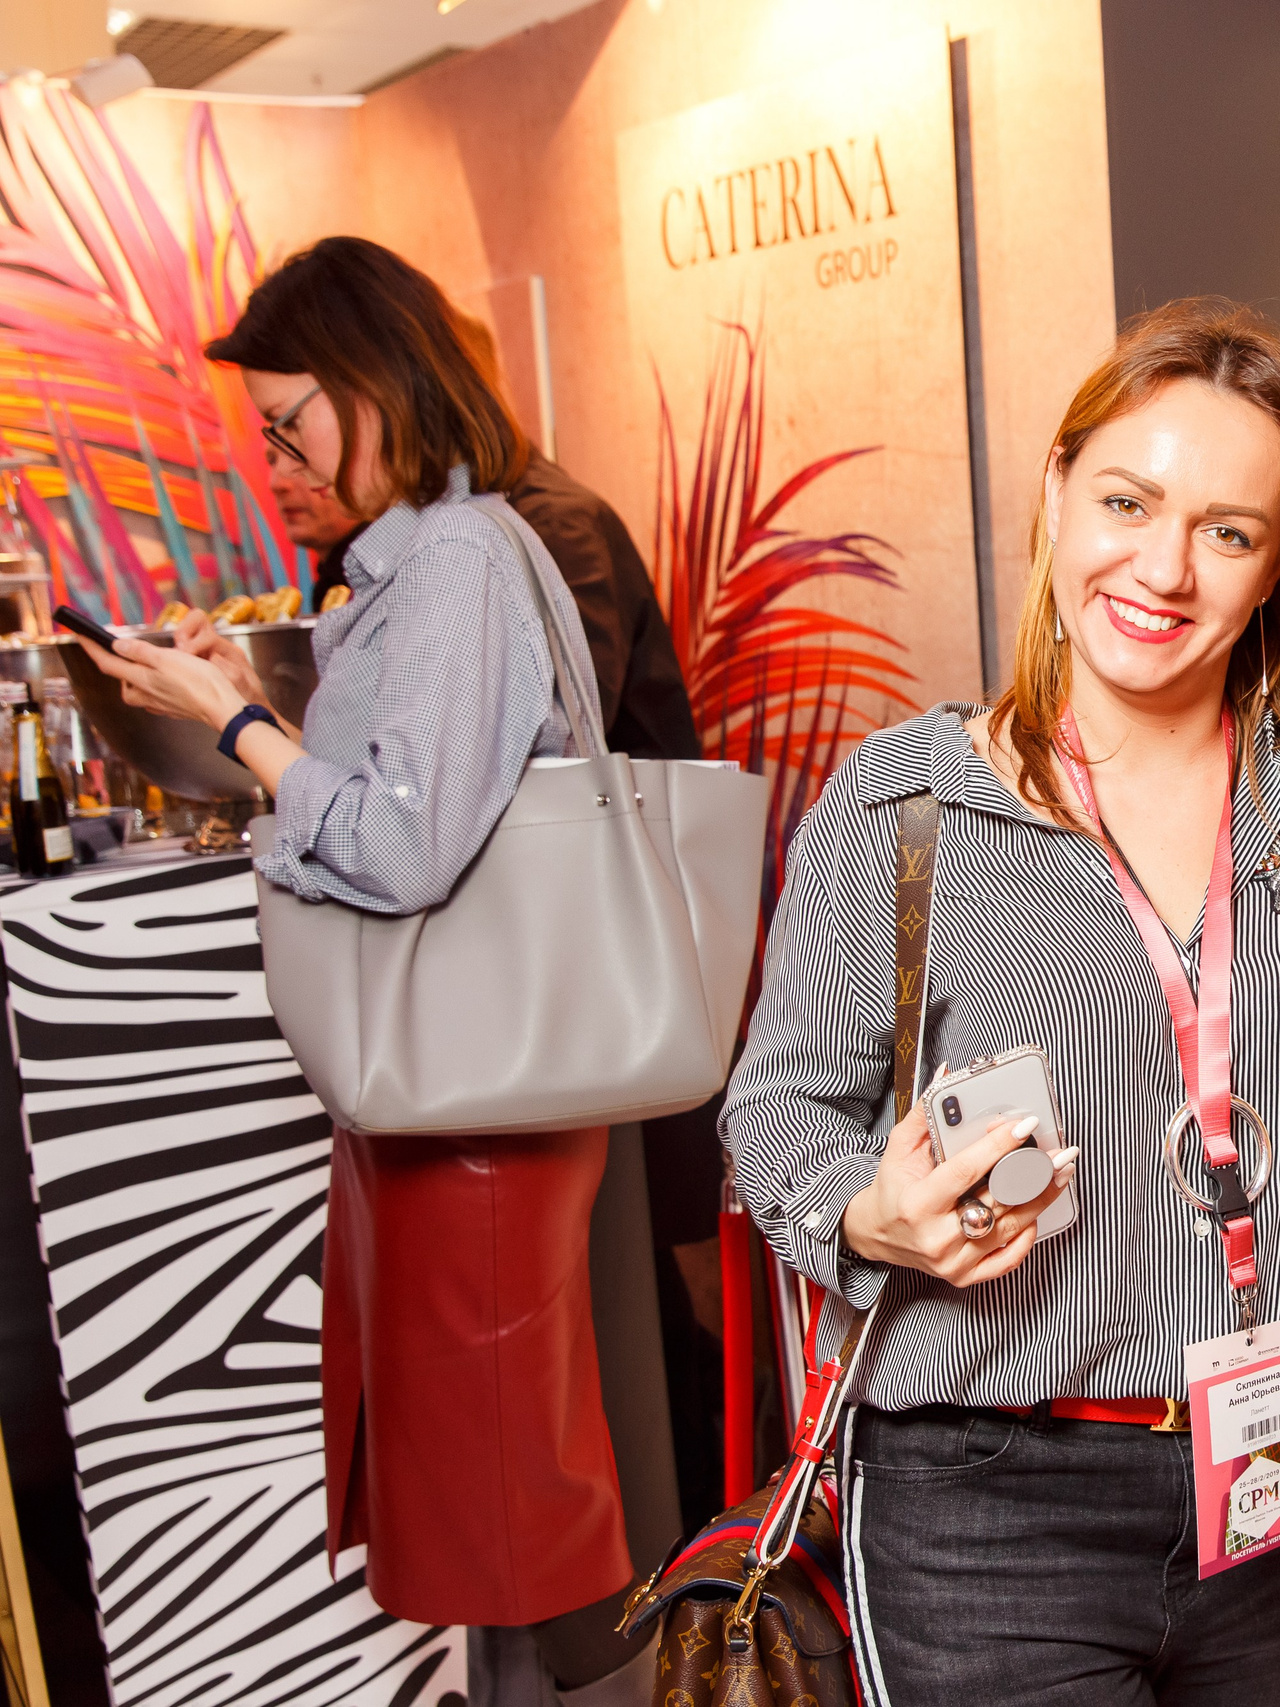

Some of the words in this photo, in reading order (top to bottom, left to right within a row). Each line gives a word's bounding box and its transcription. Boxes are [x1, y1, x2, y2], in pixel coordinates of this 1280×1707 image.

[660, 133, 898, 271] CATERINA
[814, 237, 899, 290] GROUP
[1236, 1371, 1280, 1392] Склянкина
[1228, 1394, 1249, 1408] Анна
[1238, 1481, 1280, 1514] CPM
[1231, 1542, 1266, 1561] ПОСЕТИТЕЛЬ
